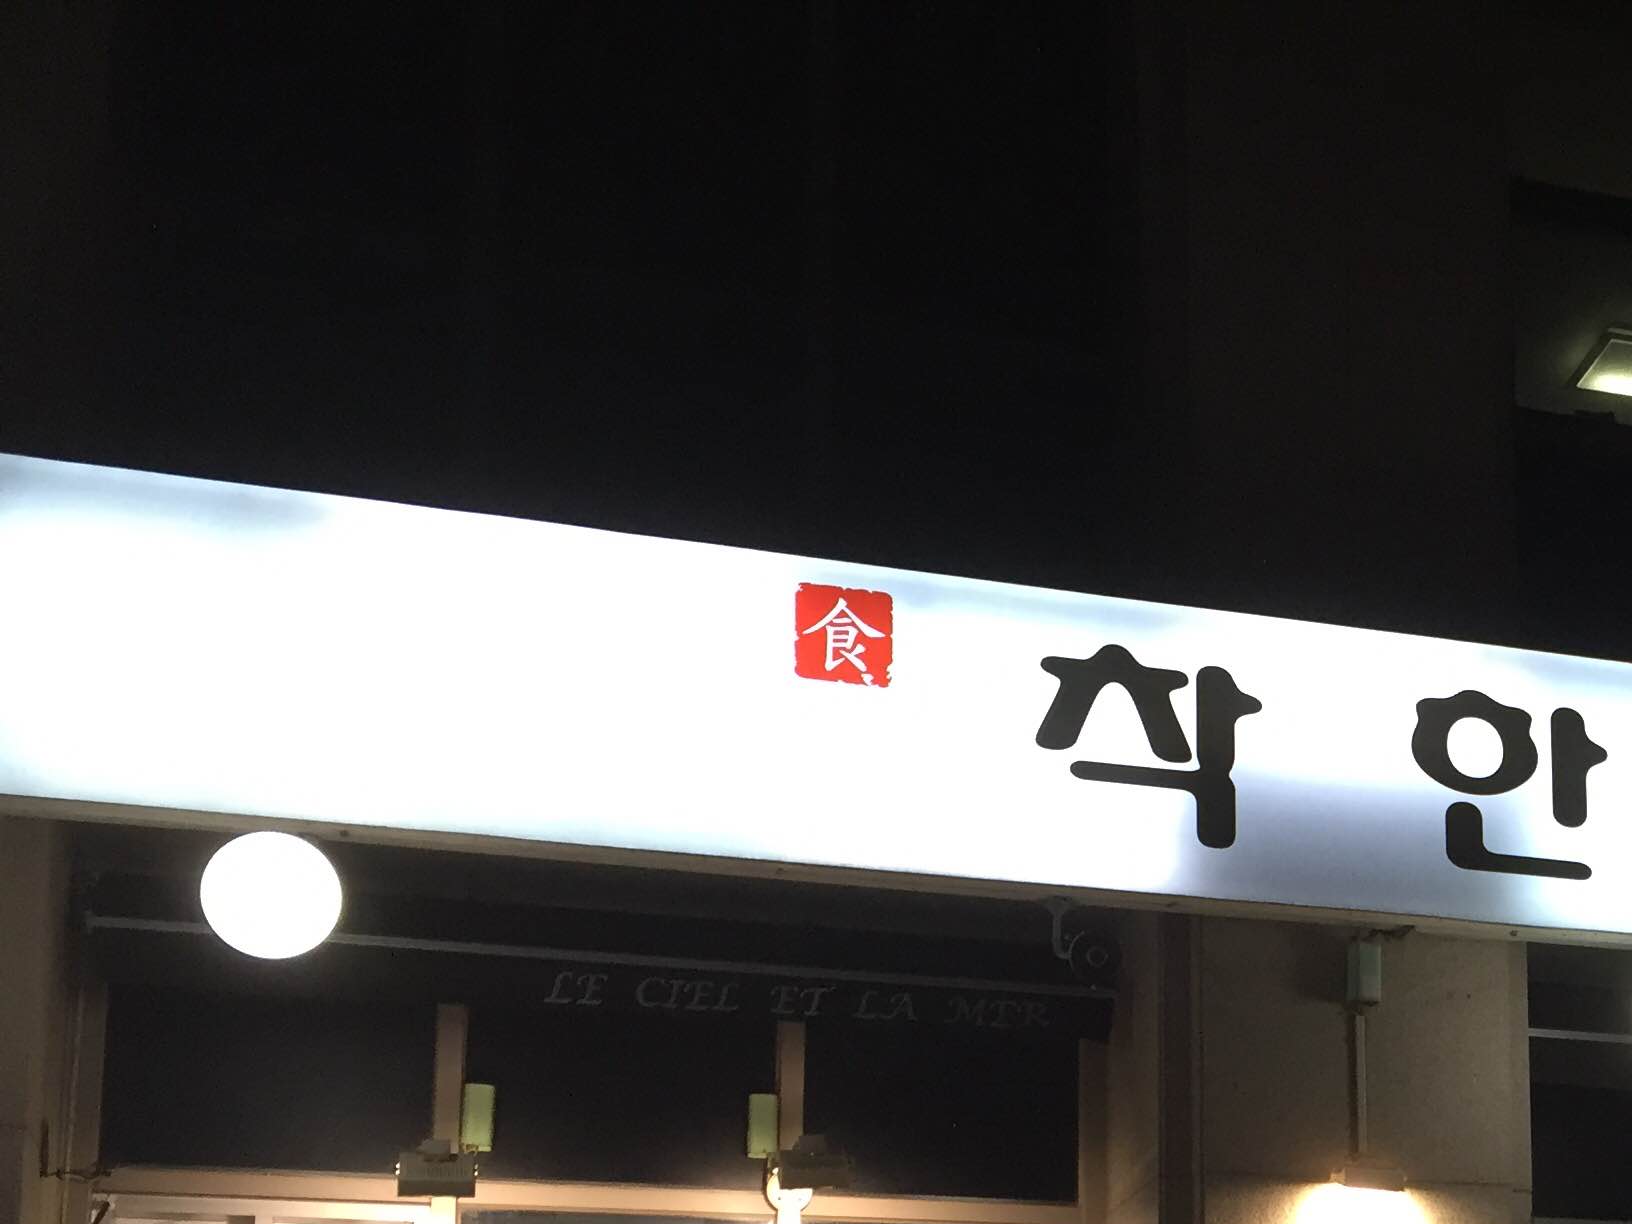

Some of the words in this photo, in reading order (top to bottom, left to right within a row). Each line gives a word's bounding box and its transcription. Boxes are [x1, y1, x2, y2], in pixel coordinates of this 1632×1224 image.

[801, 597, 886, 673] 食
[544, 970, 609, 1006] LE
[634, 976, 740, 1013] CIEL
[769, 983, 836, 1017] ET
[852, 990, 918, 1022] LA
[943, 996, 1051, 1028] MER
